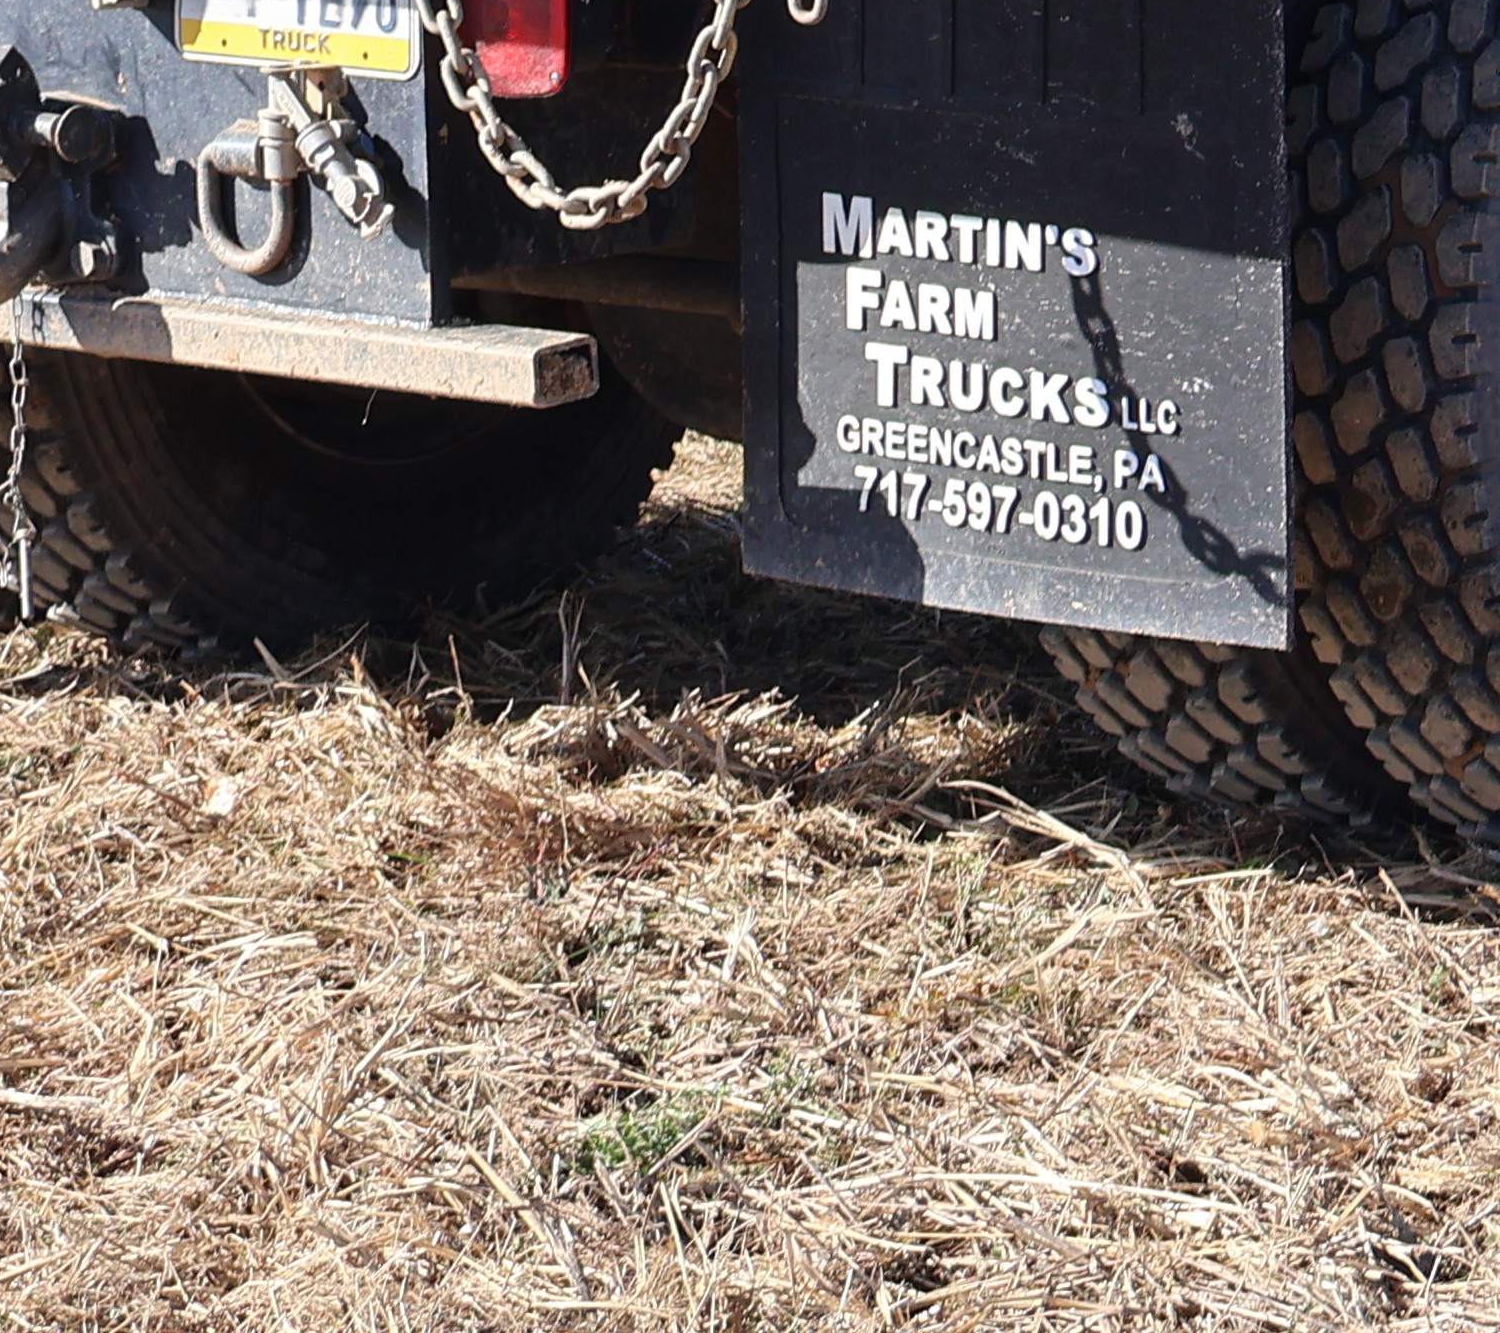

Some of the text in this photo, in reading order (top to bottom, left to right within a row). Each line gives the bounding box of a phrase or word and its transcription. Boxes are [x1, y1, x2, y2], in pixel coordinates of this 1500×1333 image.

[259, 29, 330, 53] TRUCK
[822, 192, 1097, 276] MARTIN'S
[846, 266, 994, 340] FARM
[865, 342, 1180, 435] TRUCKS LLC
[837, 415, 1166, 492] GREENCASTLE, PA
[854, 465, 1145, 550] 717-597-0310
